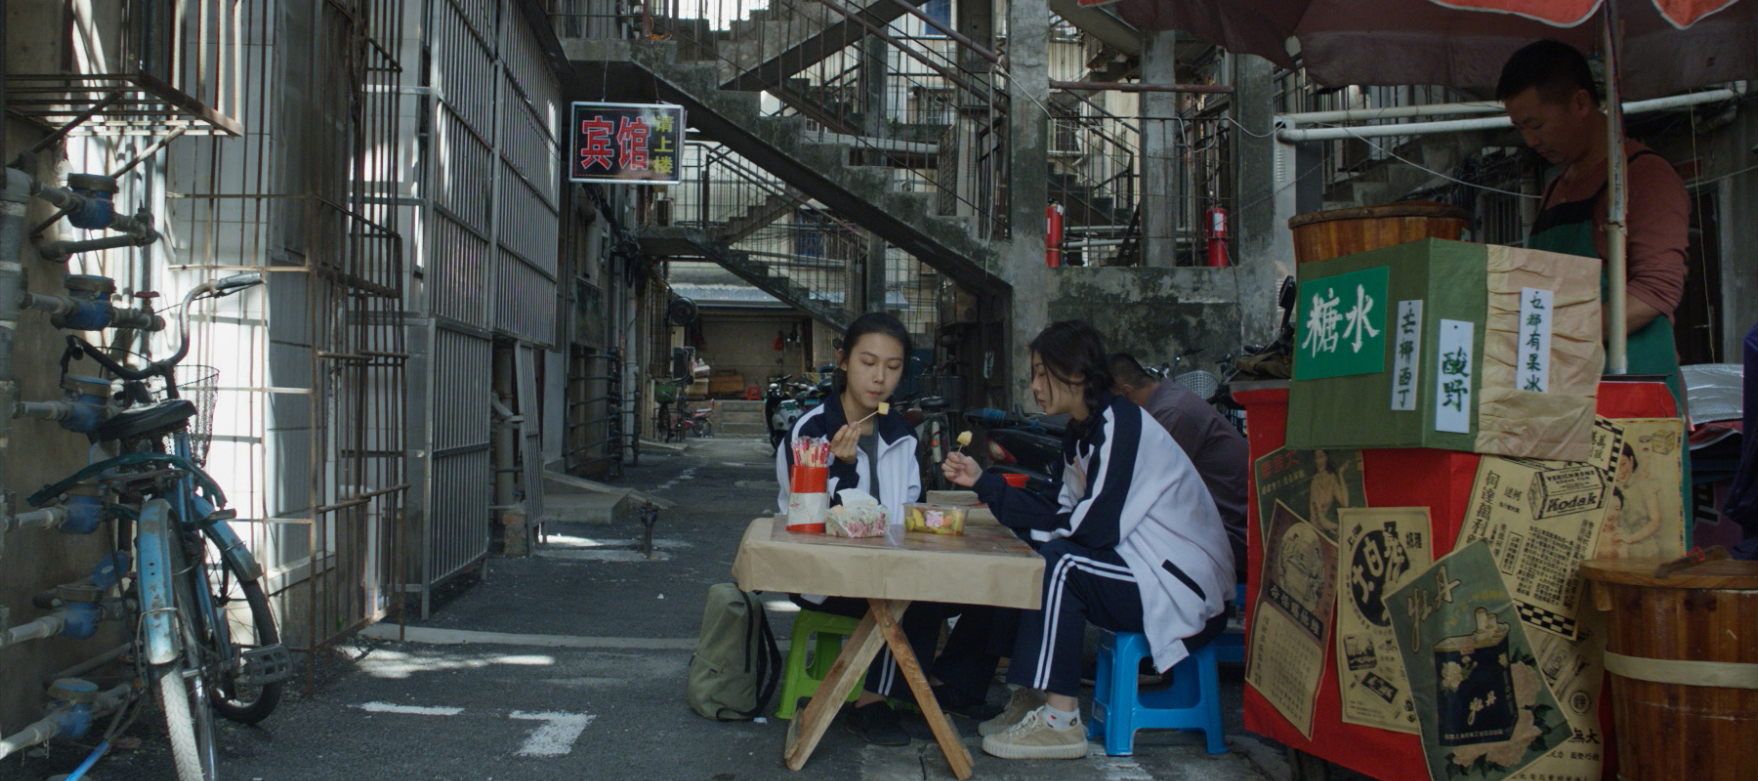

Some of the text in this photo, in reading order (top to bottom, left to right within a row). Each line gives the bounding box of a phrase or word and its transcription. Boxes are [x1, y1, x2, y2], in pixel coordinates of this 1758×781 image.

[581, 115, 651, 170] 宾馆
[653, 115, 674, 174] 请上楼
[1301, 283, 1381, 358] 糖水
[1441, 346, 1471, 413] 酸野
[1546, 492, 1597, 513] Kodak
[1407, 564, 1461, 653] 牡丹
